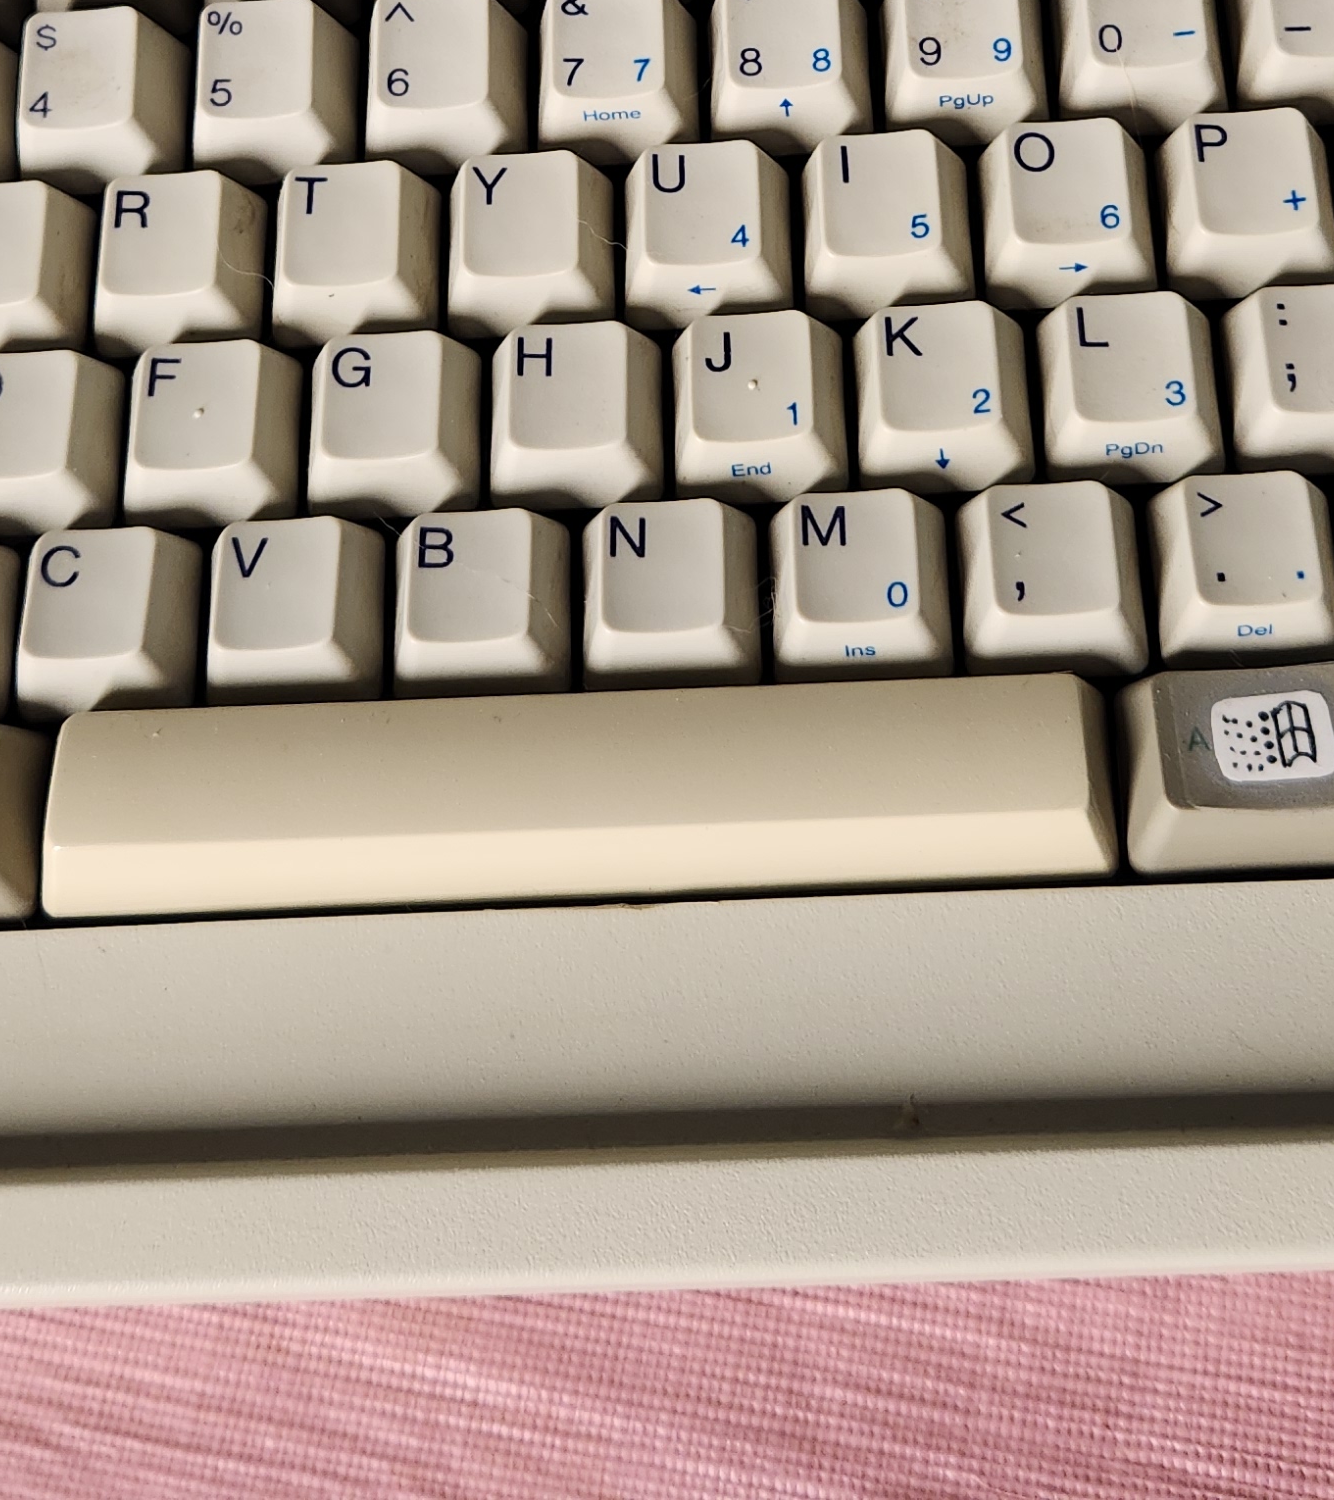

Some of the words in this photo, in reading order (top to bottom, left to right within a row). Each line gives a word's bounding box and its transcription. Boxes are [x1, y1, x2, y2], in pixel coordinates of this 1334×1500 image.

[918, 37, 941, 66] 9
[992, 38, 1011, 62] 9
[1098, 24, 1122, 53] 0
[562, 59, 584, 86] 7
[634, 59, 650, 82] 7
[739, 48, 763, 76] 8
[811, 48, 831, 72] 8
[209, 79, 232, 105] 5
[386, 68, 409, 96] 6
[29, 92, 52, 117] 4
[583, 108, 641, 122] Home
[939, 94, 994, 110] PgUp
[1013, 132, 1055, 172] O
[1194, 124, 1228, 162] P
[652, 154, 685, 193] U
[840, 146, 850, 184] I
[294, 177, 328, 215] T
[473, 167, 508, 205] Y
[114, 190, 149, 228] R
[1100, 204, 1120, 228] 6
[730, 224, 750, 247] 4
[910, 215, 929, 238] 5
[884, 317, 922, 356] K
[1076, 307, 1109, 348] L
[515, 337, 553, 377] H
[705, 331, 731, 372] J
[147, 358, 182, 397] F
[331, 347, 372, 388] G
[972, 389, 991, 413] 2
[1165, 381, 1186, 405] 3
[787, 402, 799, 426] 1
[1105, 441, 1164, 459] PgDn
[732, 461, 771, 478] End
[609, 516, 646, 558] N
[801, 506, 846, 546] M
[231, 537, 269, 578] V
[418, 527, 454, 569] B
[40, 545, 80, 587] C
[886, 582, 908, 607] 0
[1237, 624, 1273, 637] Del
[845, 644, 876, 658] Ins
